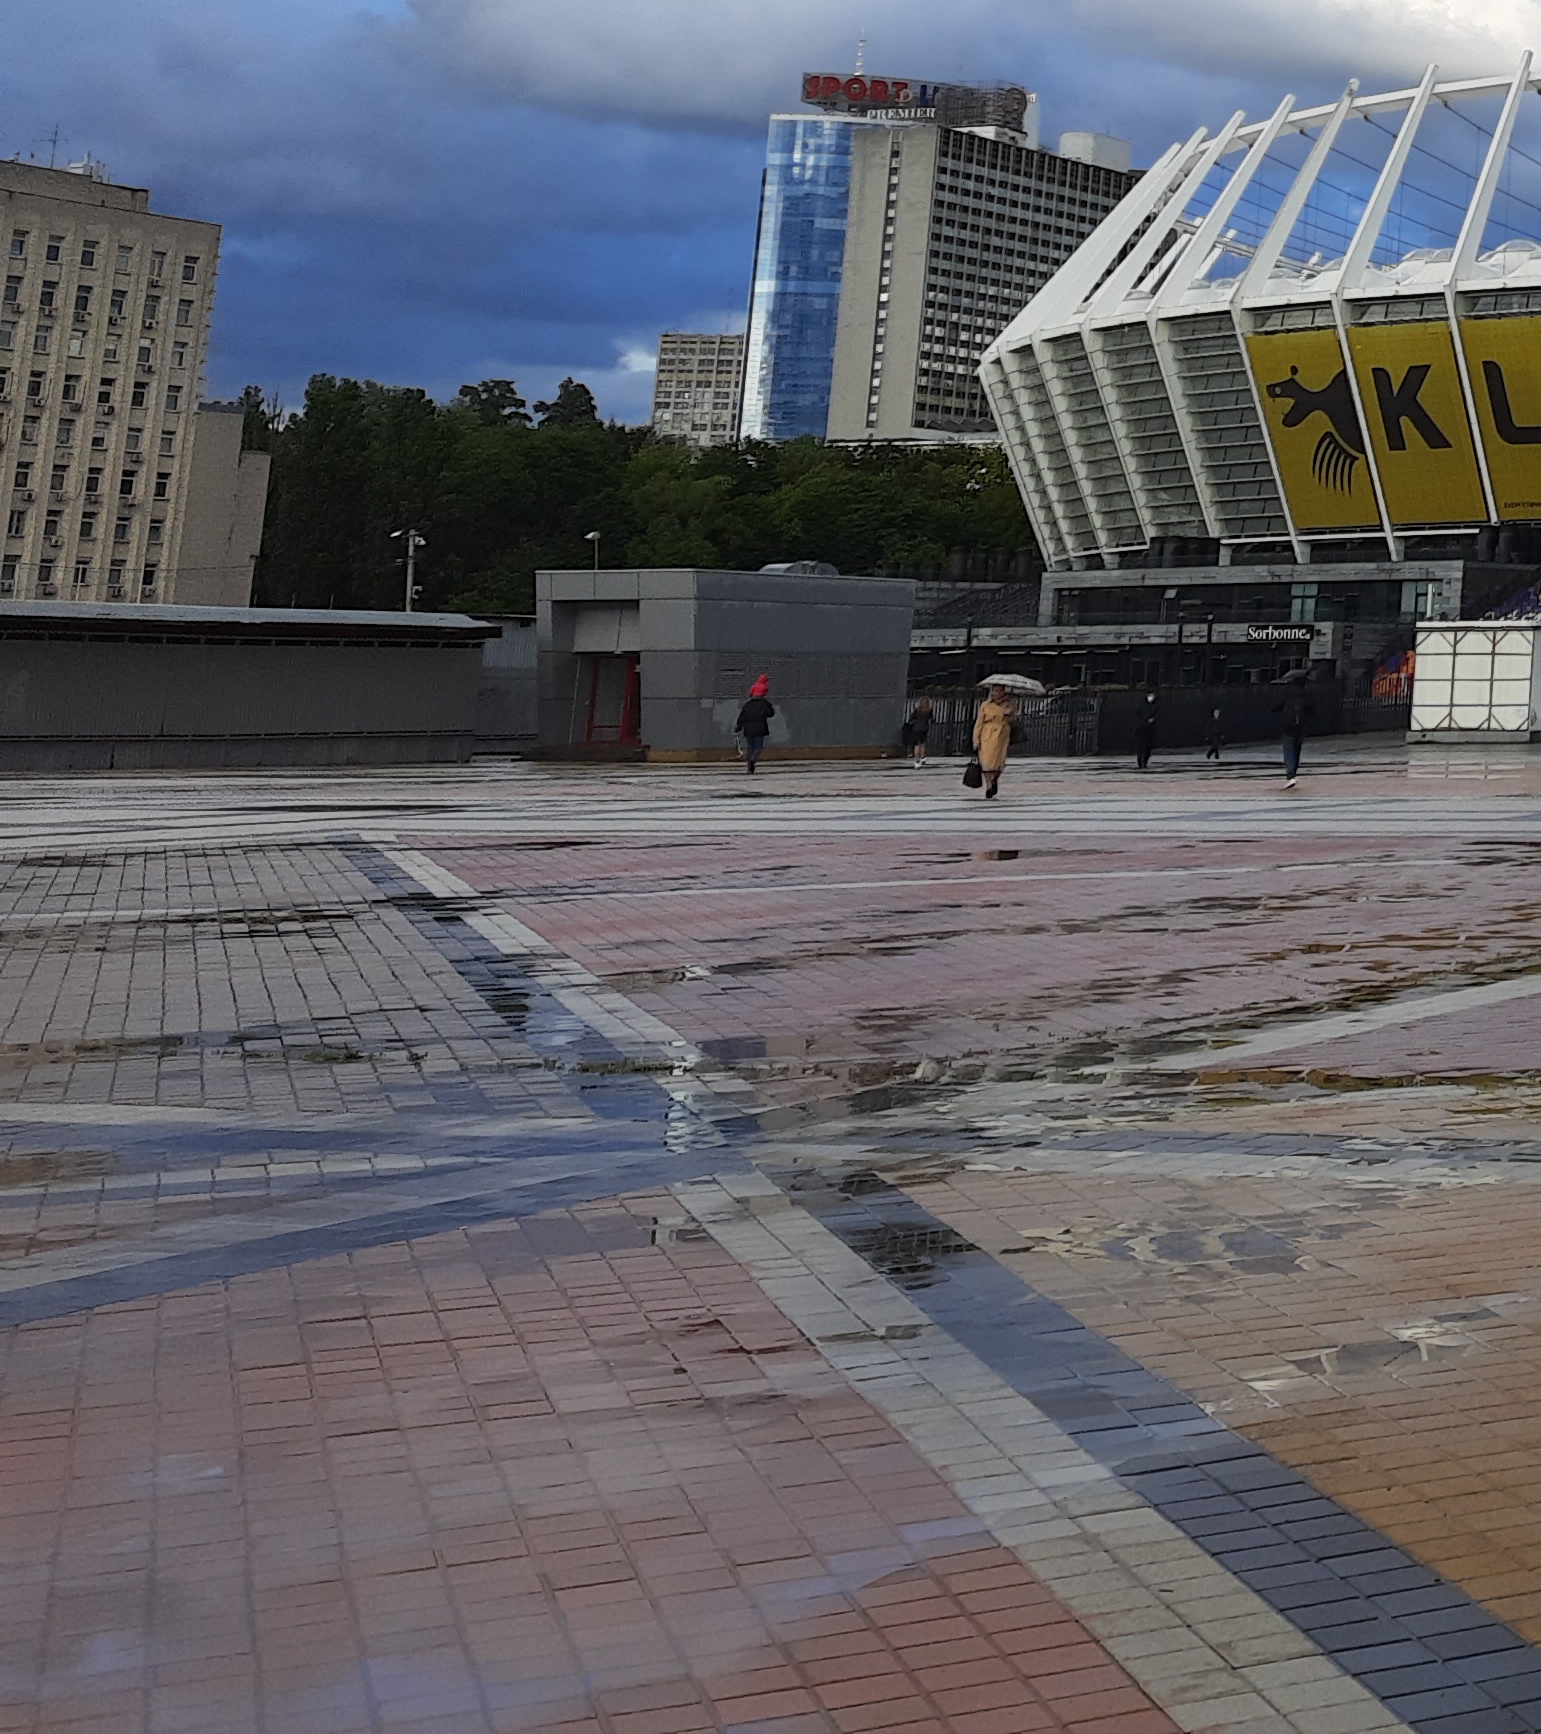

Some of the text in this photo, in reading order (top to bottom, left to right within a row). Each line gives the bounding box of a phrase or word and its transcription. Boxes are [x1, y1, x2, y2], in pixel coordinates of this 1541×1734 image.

[805, 75, 908, 104] SPORT
[867, 107, 937, 120] PREMIER
[1247, 626, 1311, 640] Sorbonne
